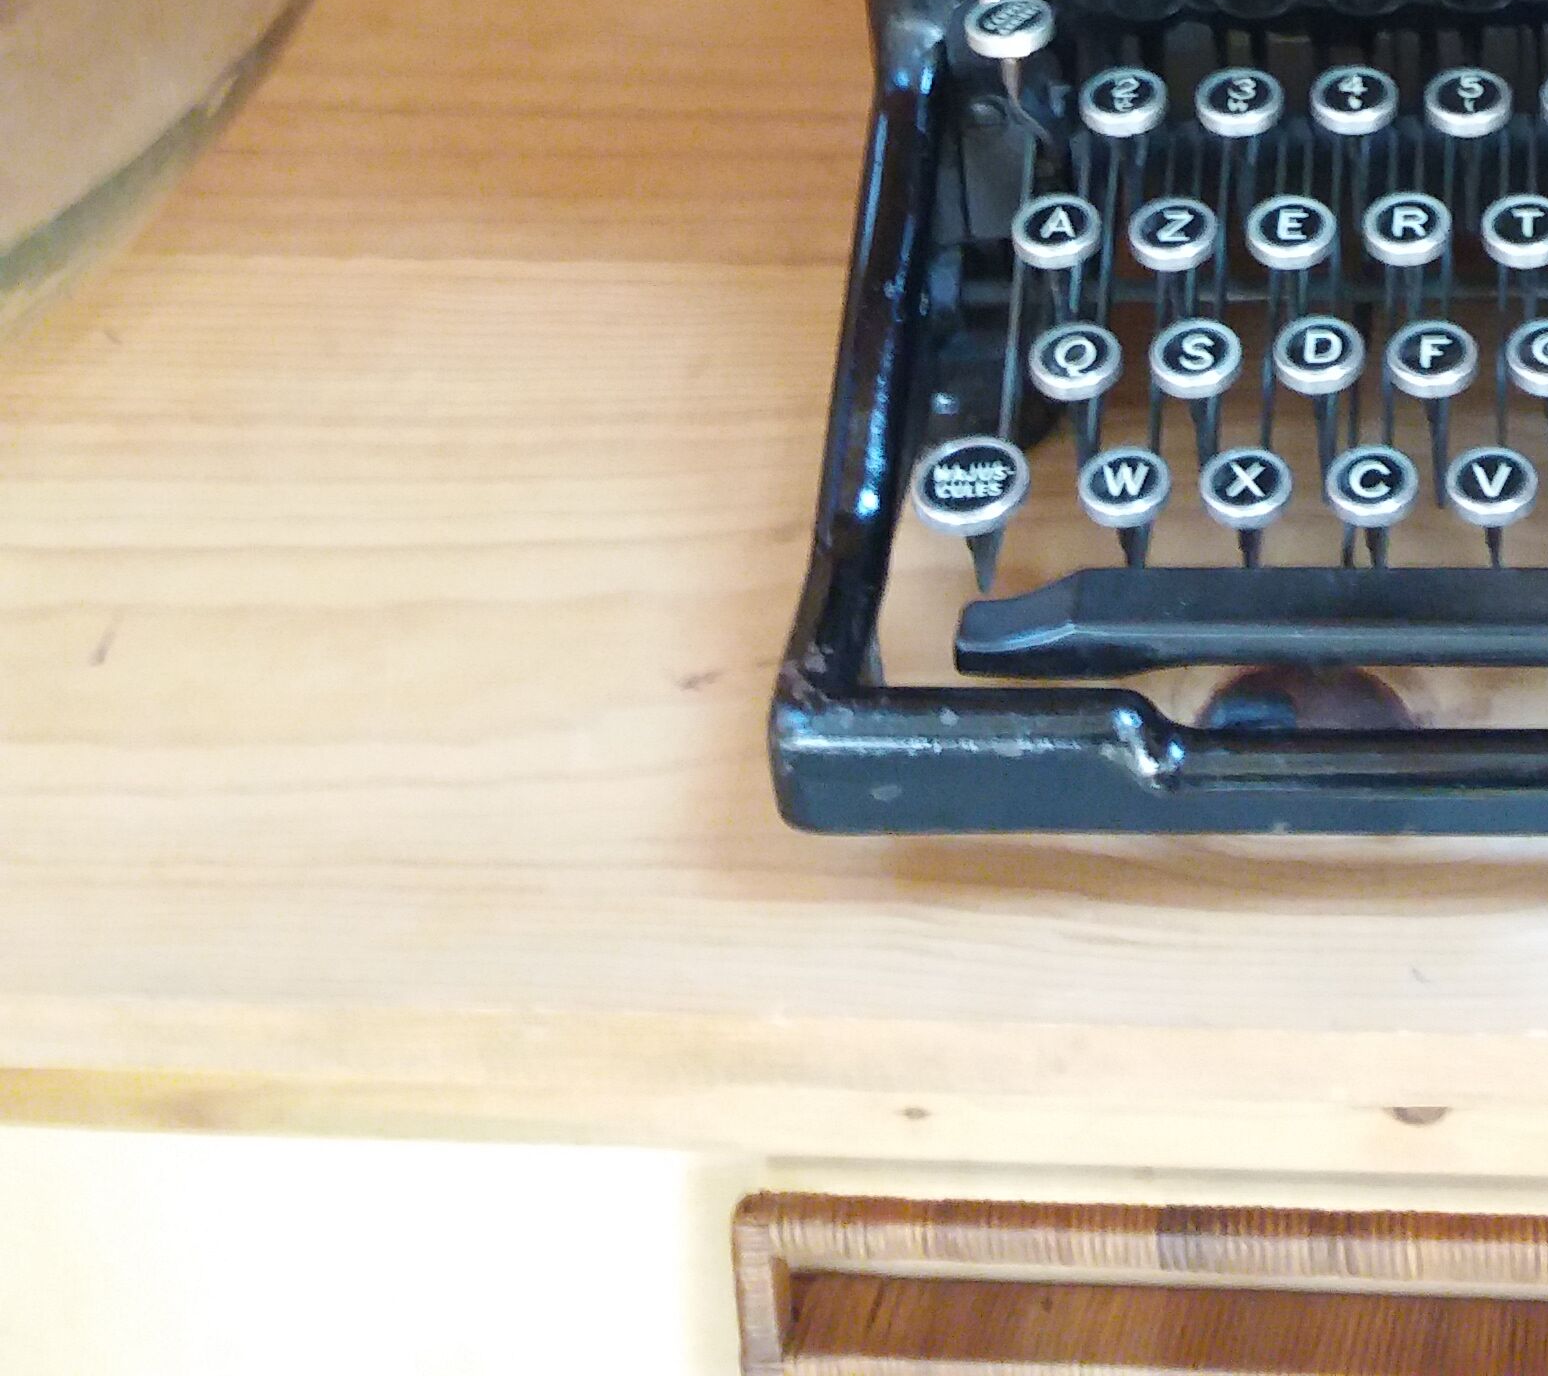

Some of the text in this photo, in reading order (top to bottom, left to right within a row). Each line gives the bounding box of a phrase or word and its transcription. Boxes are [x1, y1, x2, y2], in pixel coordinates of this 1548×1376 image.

[1111, 76, 1140, 98] 2
[1227, 77, 1257, 100] 3
[1338, 74, 1368, 96] 4
[1456, 75, 1486, 98] 5
[1039, 206, 1076, 239] A
[1156, 210, 1194, 242] Z
[1276, 208, 1309, 241] E
[1391, 206, 1429, 237] R
[1511, 207, 1545, 238] T
[1054, 338, 1098, 378] Q
[1179, 333, 1215, 371] S
[1303, 328, 1343, 364] D
[1419, 335, 1453, 369] F
[1102, 464, 1150, 497] W
[1229, 463, 1266, 498] X
[1348, 459, 1391, 499] C
[1471, 462, 1513, 498] V
